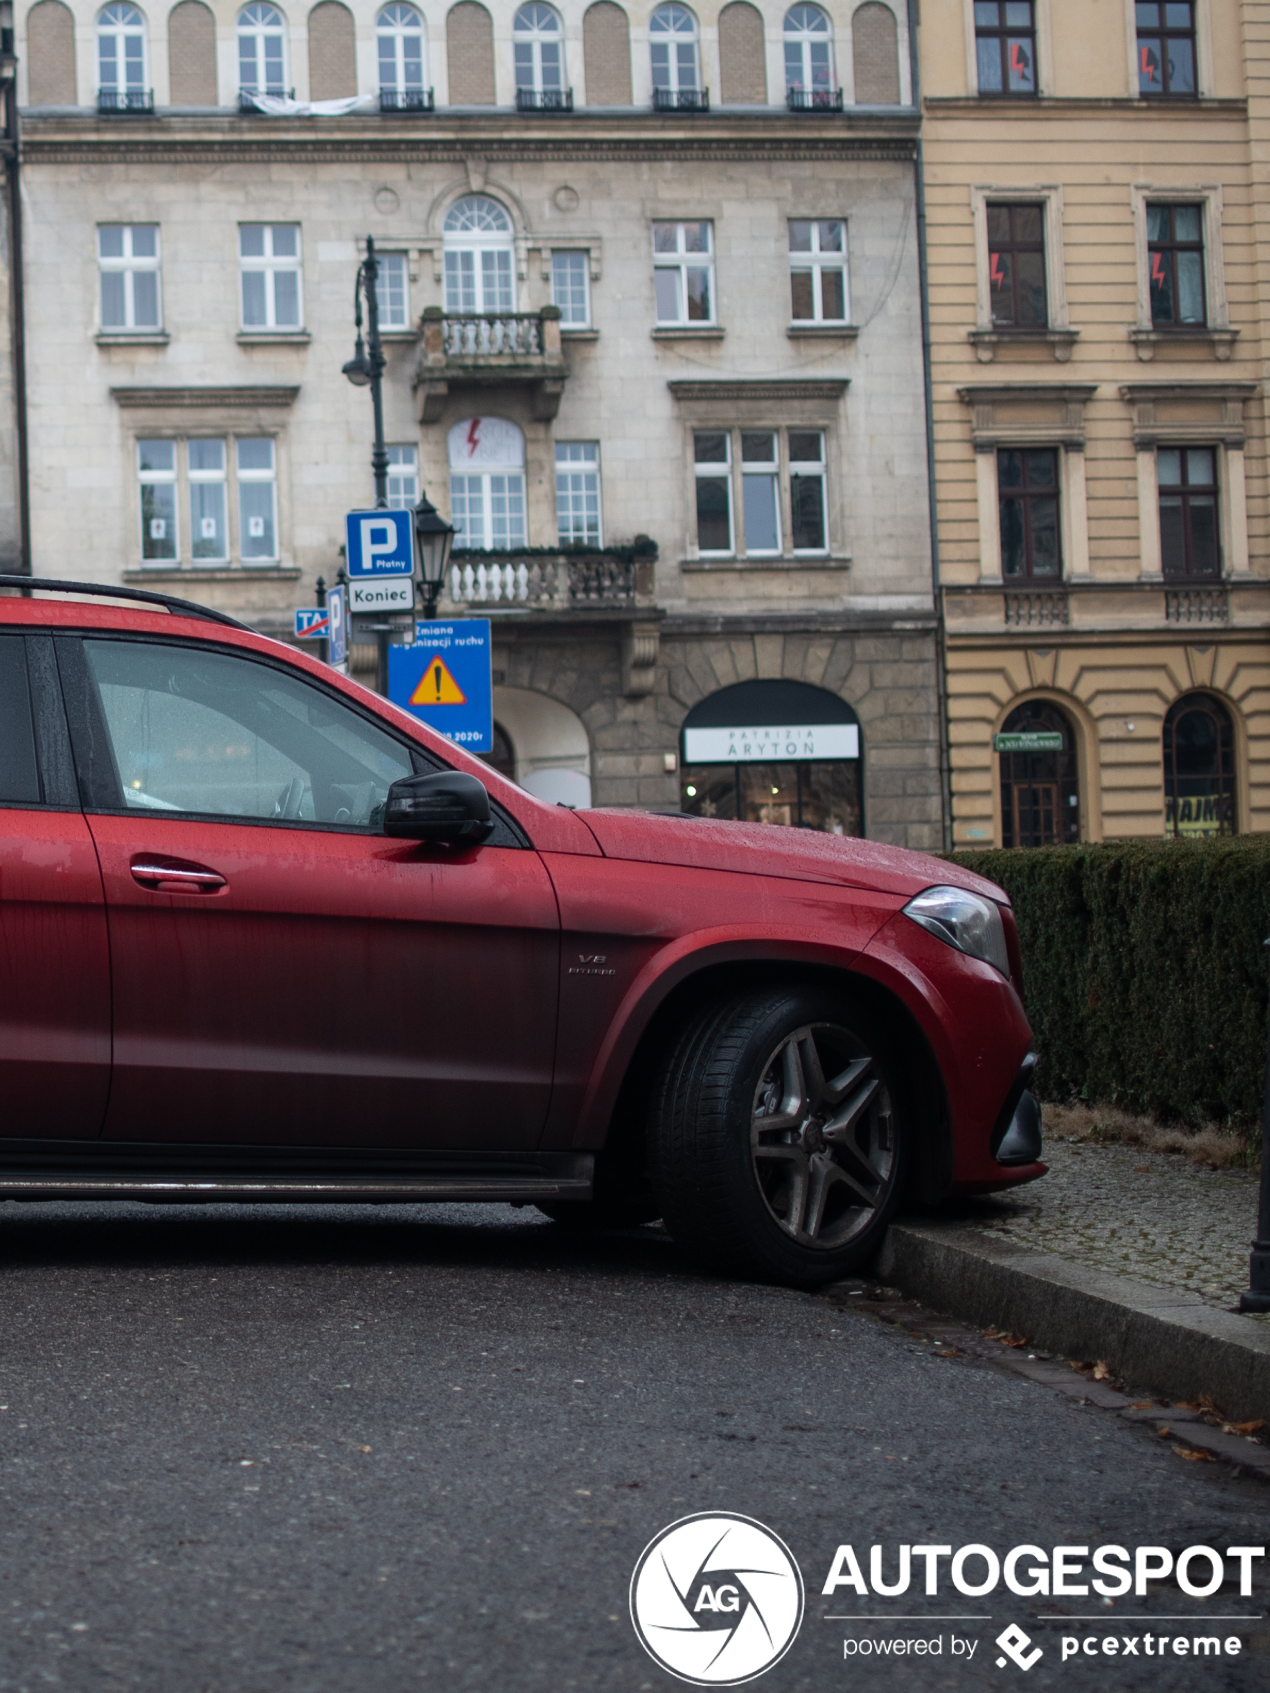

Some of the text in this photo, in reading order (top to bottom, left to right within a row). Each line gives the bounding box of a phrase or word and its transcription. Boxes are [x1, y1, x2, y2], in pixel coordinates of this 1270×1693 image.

[360, 518, 398, 569] P
[354, 588, 407, 603] Koniec
[298, 612, 330, 635] TA
[455, 635, 484, 646] ruchu
[729, 729, 814, 740] PATRIZIA
[728, 742, 815, 757] ARYTON
[579, 954, 607, 964] V8
[568, 967, 616, 976] BITURBO
